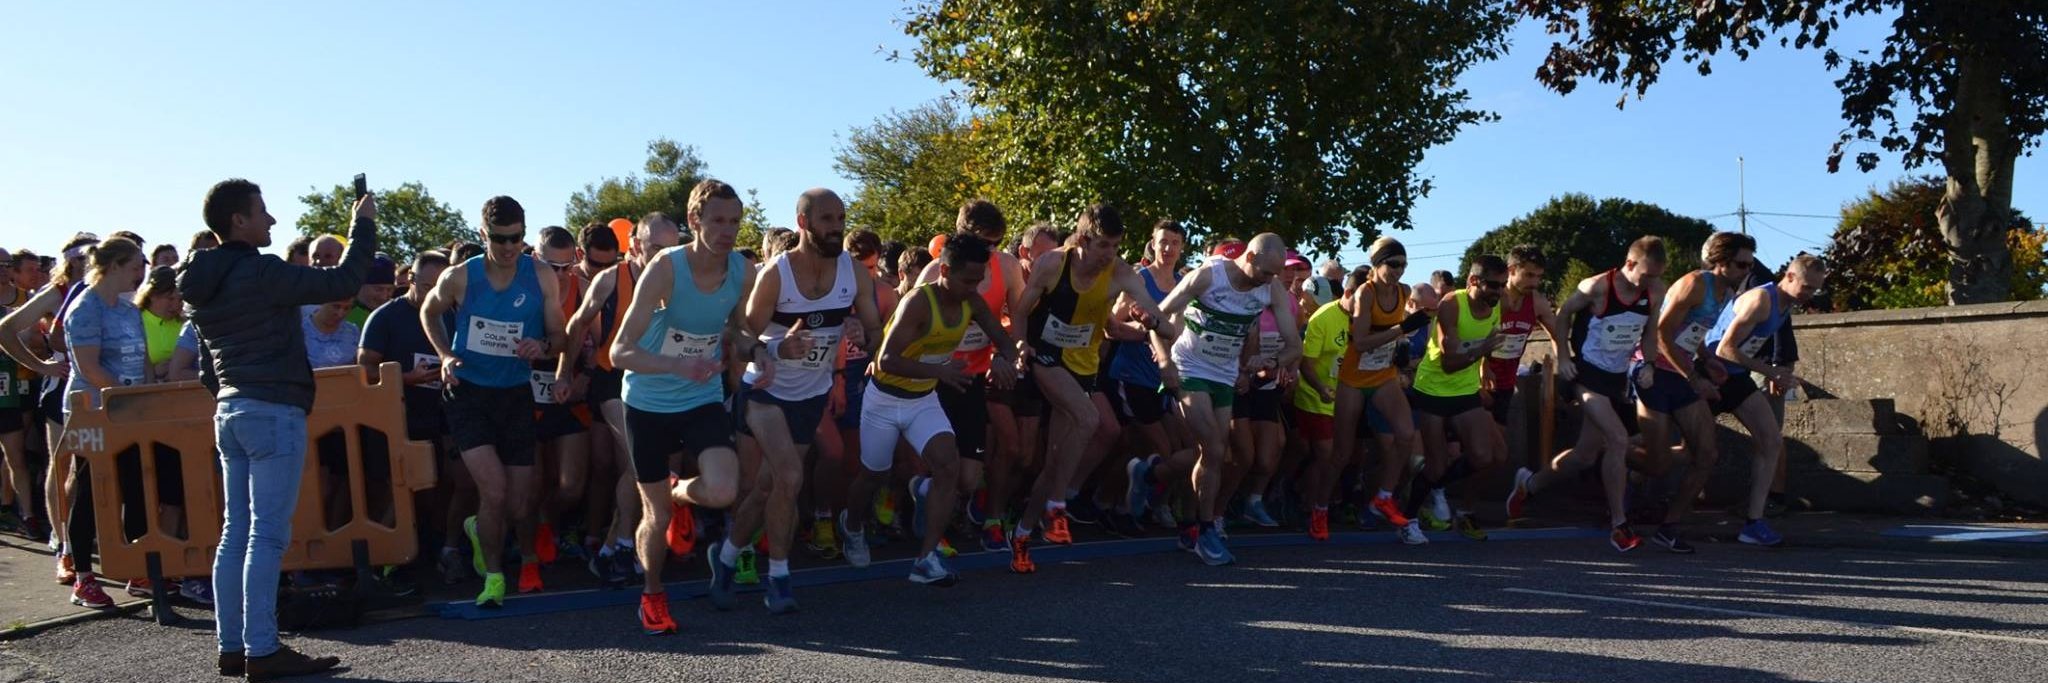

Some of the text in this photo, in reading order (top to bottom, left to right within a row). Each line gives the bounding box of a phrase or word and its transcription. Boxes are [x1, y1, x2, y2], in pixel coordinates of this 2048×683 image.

[484, 333, 507, 342] COLIN
[480, 339, 509, 349] GRIFFIN
[66, 427, 105, 453] CPH
